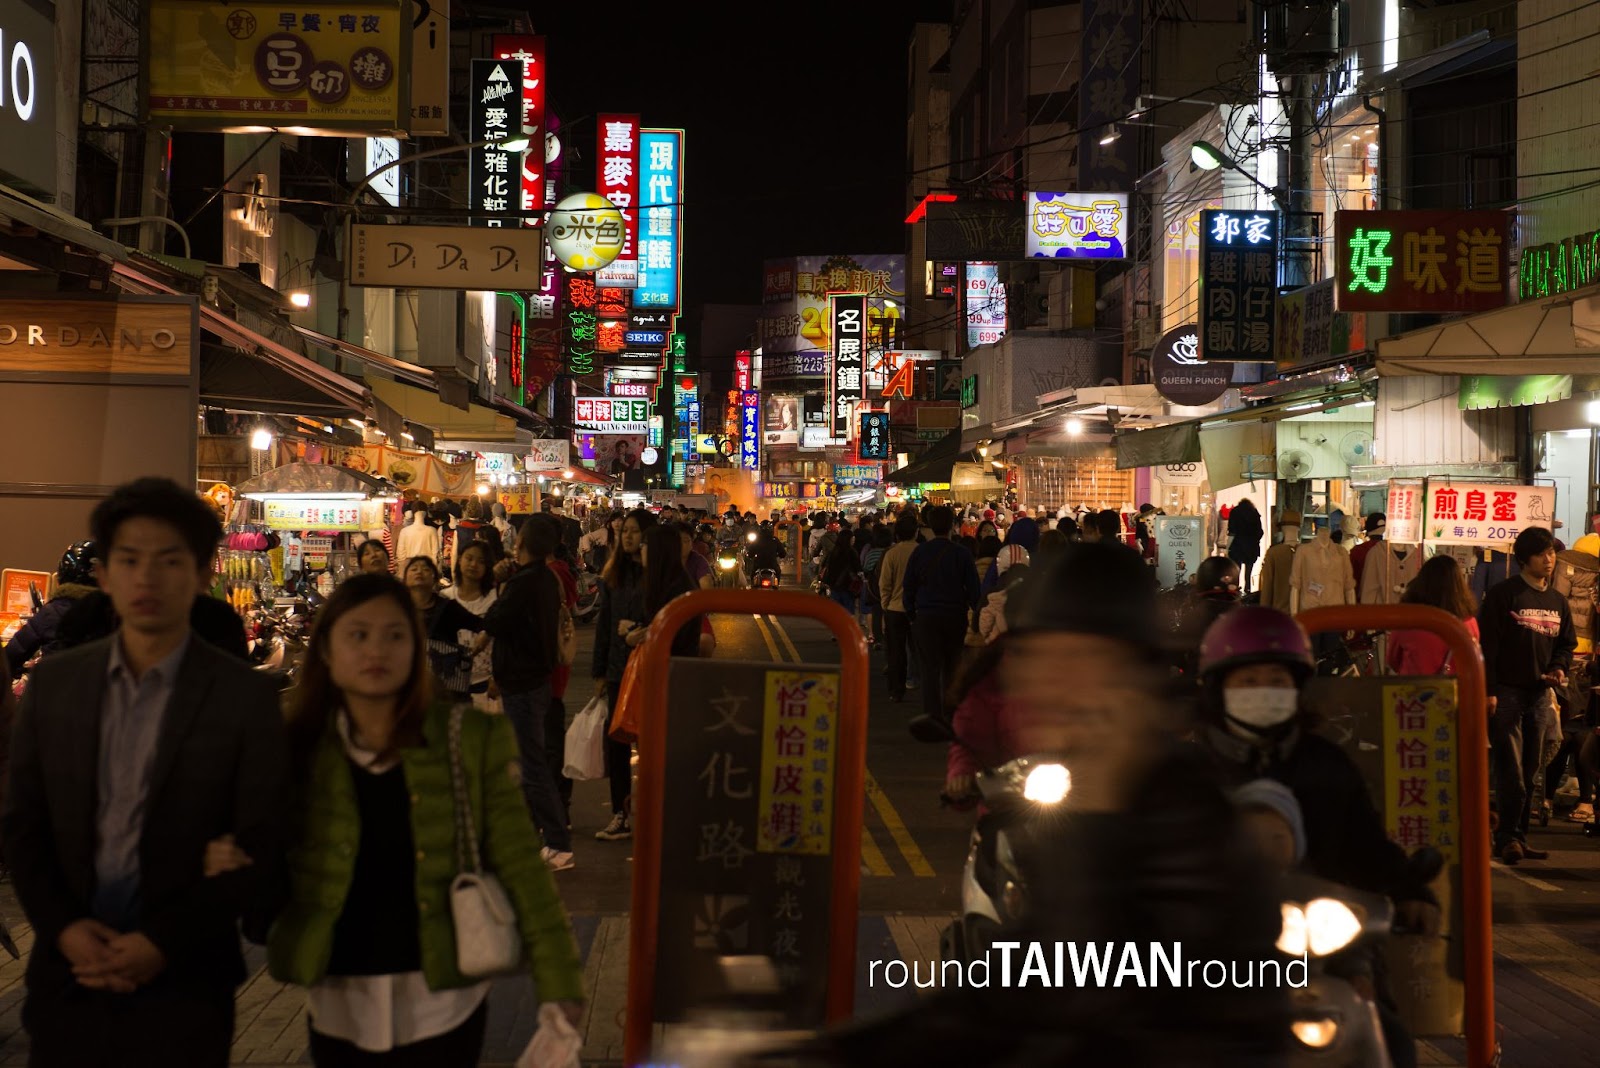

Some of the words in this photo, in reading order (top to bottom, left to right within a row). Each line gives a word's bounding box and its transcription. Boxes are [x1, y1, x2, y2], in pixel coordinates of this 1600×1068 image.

[1348, 227, 1503, 294] 好味道
[626, 334, 664, 342] SEIKO
[1161, 376, 1192, 384] QUEEN
[1195, 377, 1226, 385] PUNCH
[614, 384, 647, 396] DIESEL
[622, 423, 647, 431] SHOES
[1434, 488, 1518, 522] 煎鳥蛋
[1452, 527, 1478, 538] 每份
[1519, 608, 1561, 617] ORIGINAL
[1395, 698, 1428, 847] 恰恰皮鞋
[695, 689, 757, 869] 文化路
